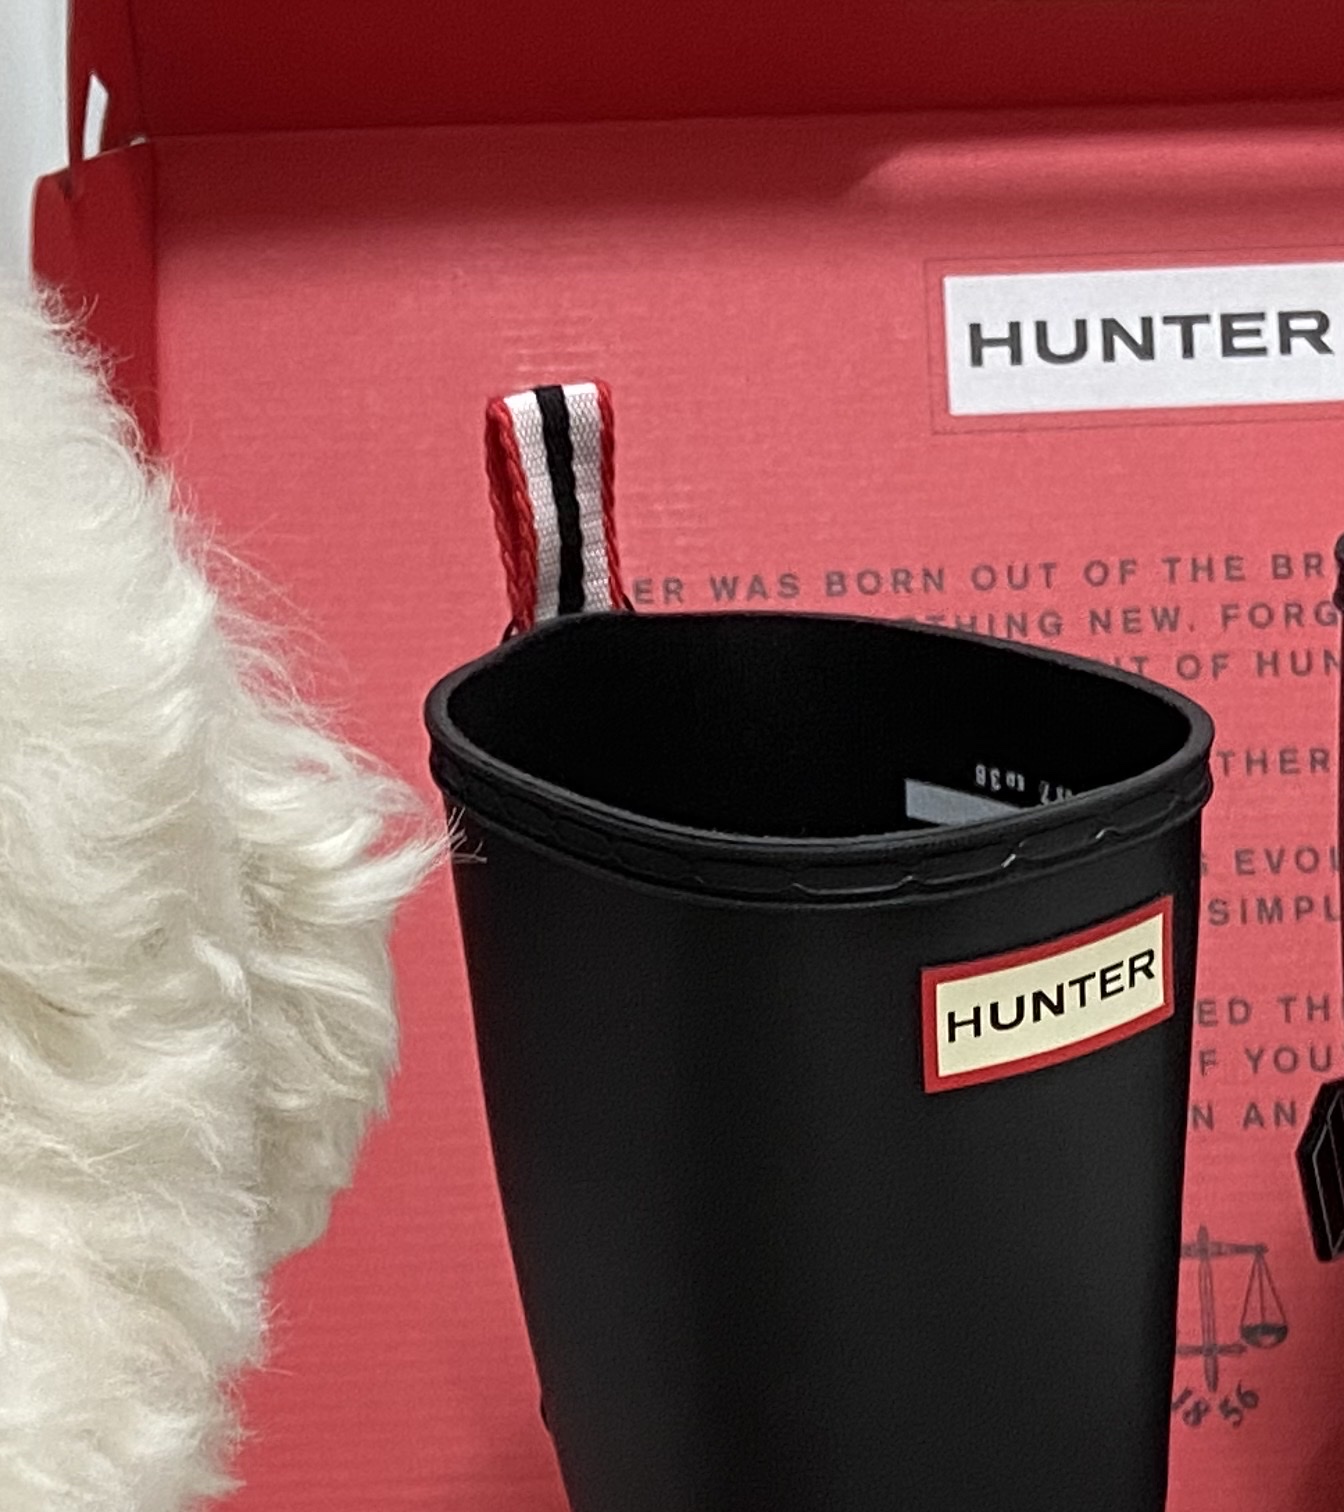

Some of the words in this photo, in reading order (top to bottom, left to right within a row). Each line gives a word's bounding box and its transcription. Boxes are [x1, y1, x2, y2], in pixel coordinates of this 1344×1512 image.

[969, 309, 1335, 367] HUNTER
[710, 572, 800, 602] WAS
[825, 567, 945, 598] BORN
[971, 561, 1057, 592] OUT
[1084, 558, 1136, 587] OF
[1162, 555, 1246, 585] THE
[1176, 653, 1229, 680] OF
[948, 948, 1155, 1044] HUNTER
